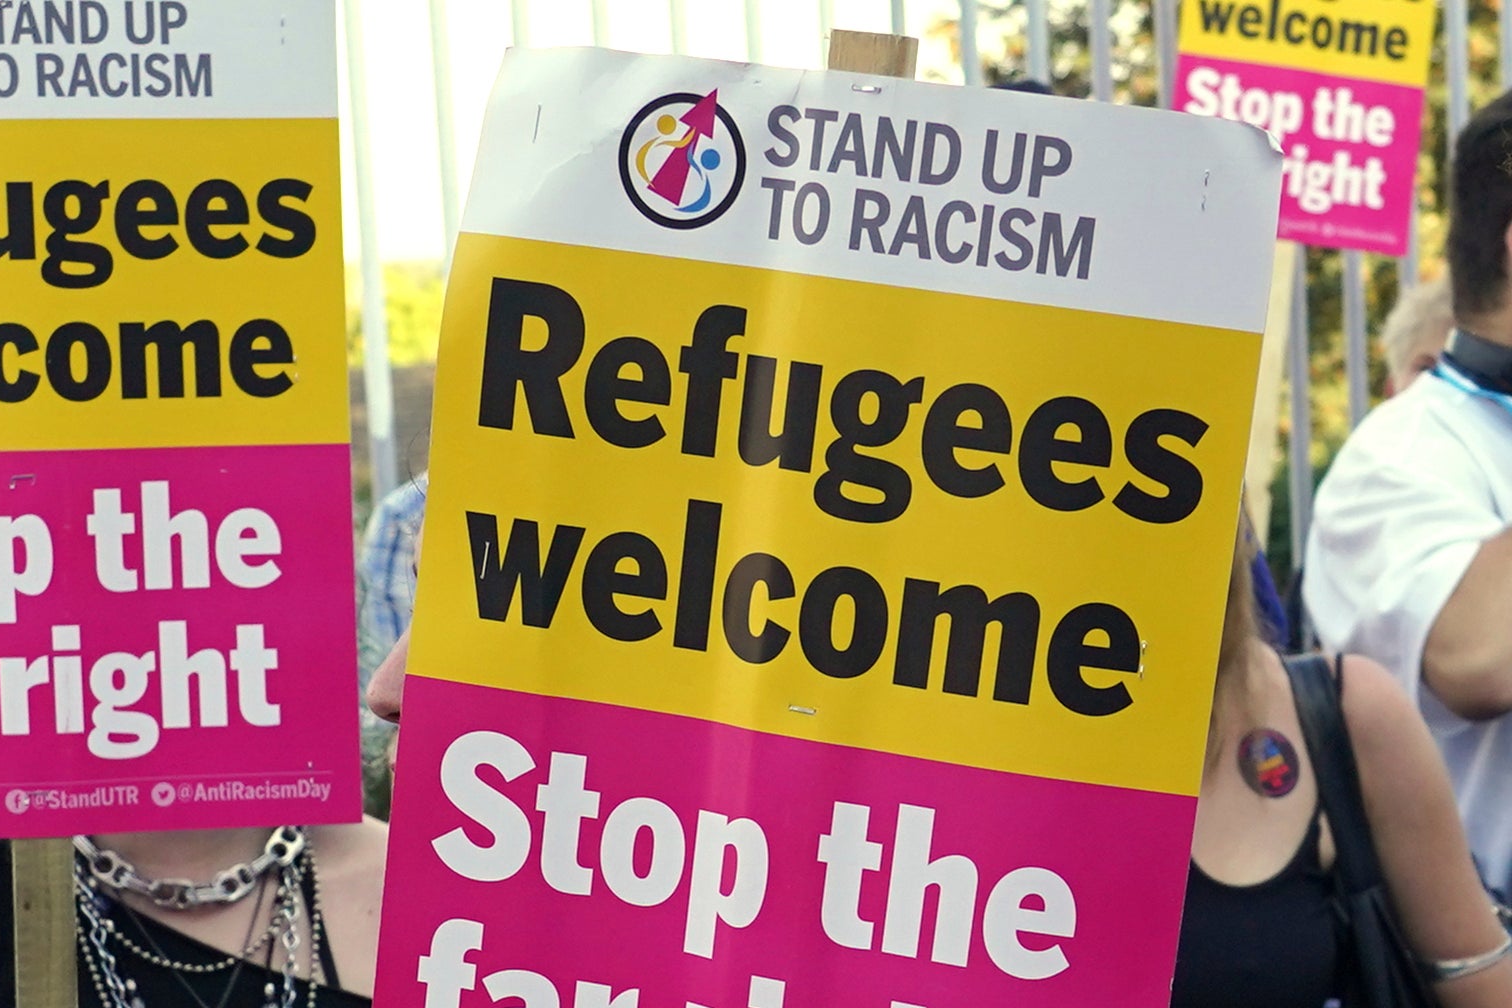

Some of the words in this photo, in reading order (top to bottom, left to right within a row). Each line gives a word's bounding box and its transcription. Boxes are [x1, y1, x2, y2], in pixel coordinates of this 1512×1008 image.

[125, 1, 187, 44] UP
[1199, 0, 1409, 61] welcome
[36, 53, 212, 97] RACISM
[1313, 87, 1395, 146] the
[764, 105, 961, 185] STAND
[982, 129, 1072, 198] UP
[761, 177, 830, 244] TO
[849, 189, 1095, 279] RACISM
[479, 277, 1209, 524] Refugees
[87, 481, 281, 592] the
[466, 499, 1140, 716] welcome
[33, 786, 138, 809] @StandUTR
[177, 779, 331, 802] @AntiRacismDay
[432, 731, 768, 959] Stop
[817, 802, 1076, 980] the
